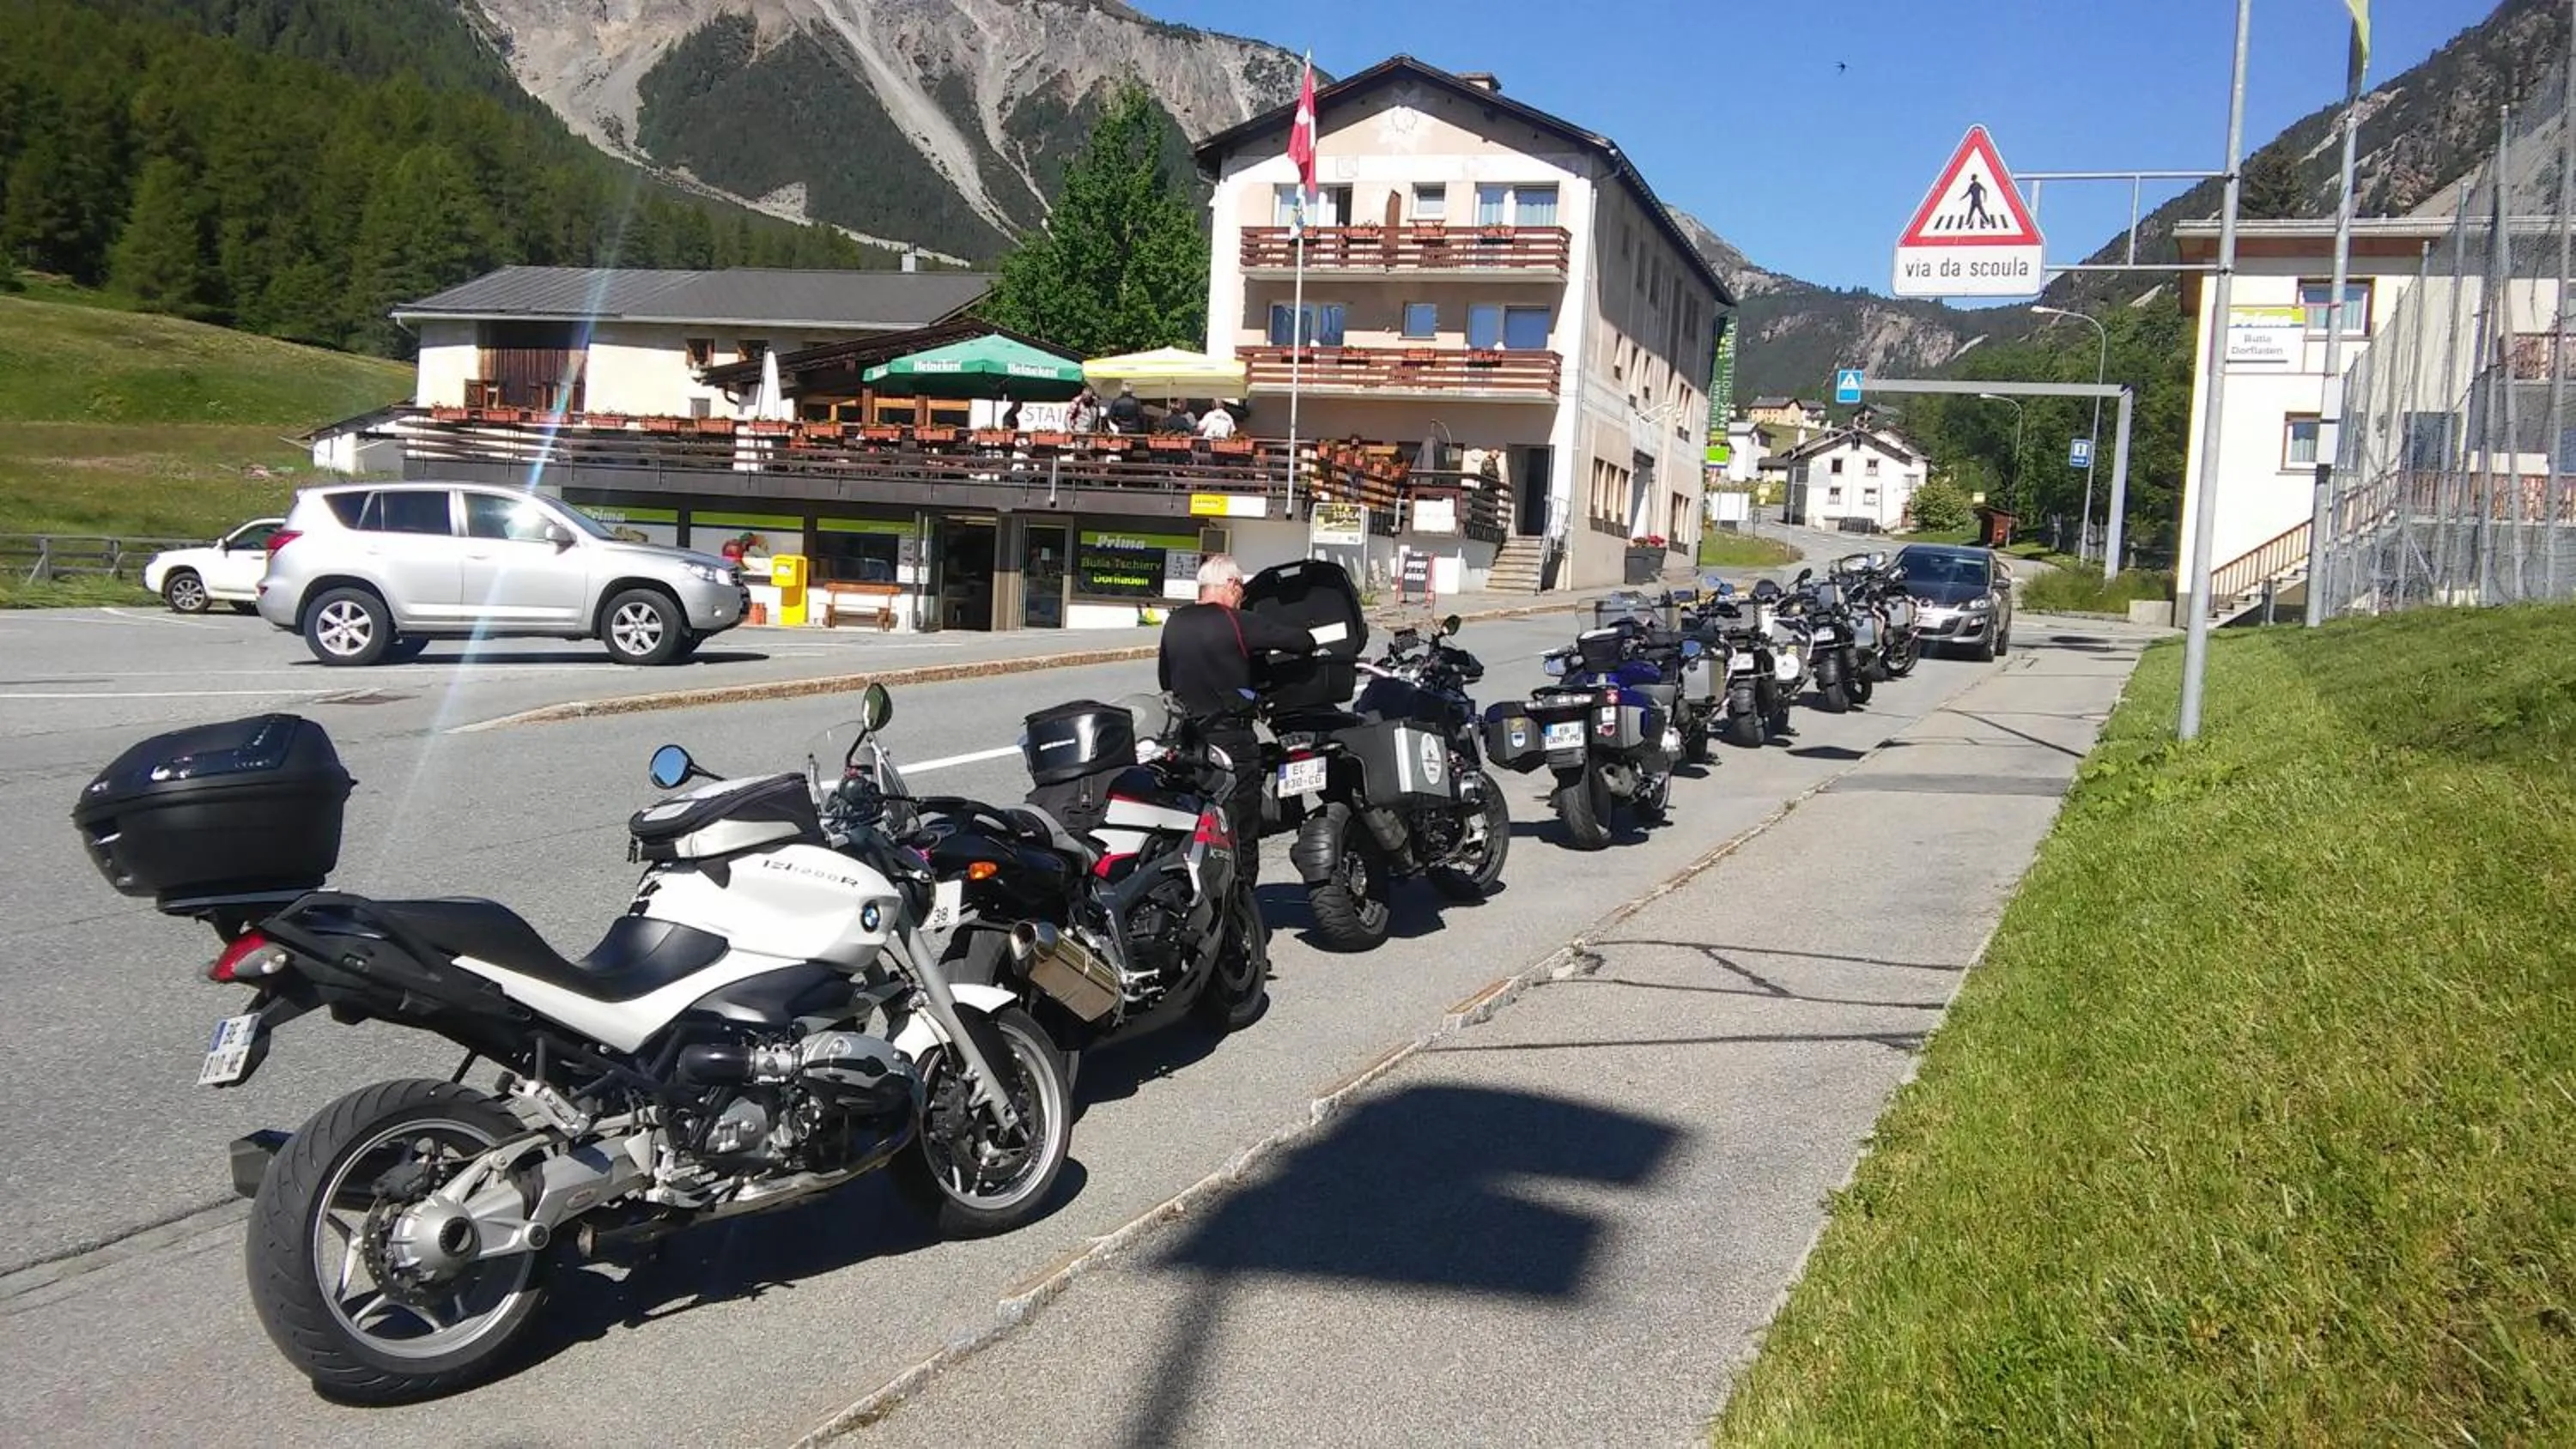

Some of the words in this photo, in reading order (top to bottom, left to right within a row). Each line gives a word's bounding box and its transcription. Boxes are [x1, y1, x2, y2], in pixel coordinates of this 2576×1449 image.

[1905, 258, 1931, 277] via
[1940, 258, 1960, 277] da
[1970, 257, 2029, 276] scoula
[913, 360, 962, 372] Heineken
[1008, 363, 1059, 378] Heineken
[1096, 534, 1145, 549] Prima
